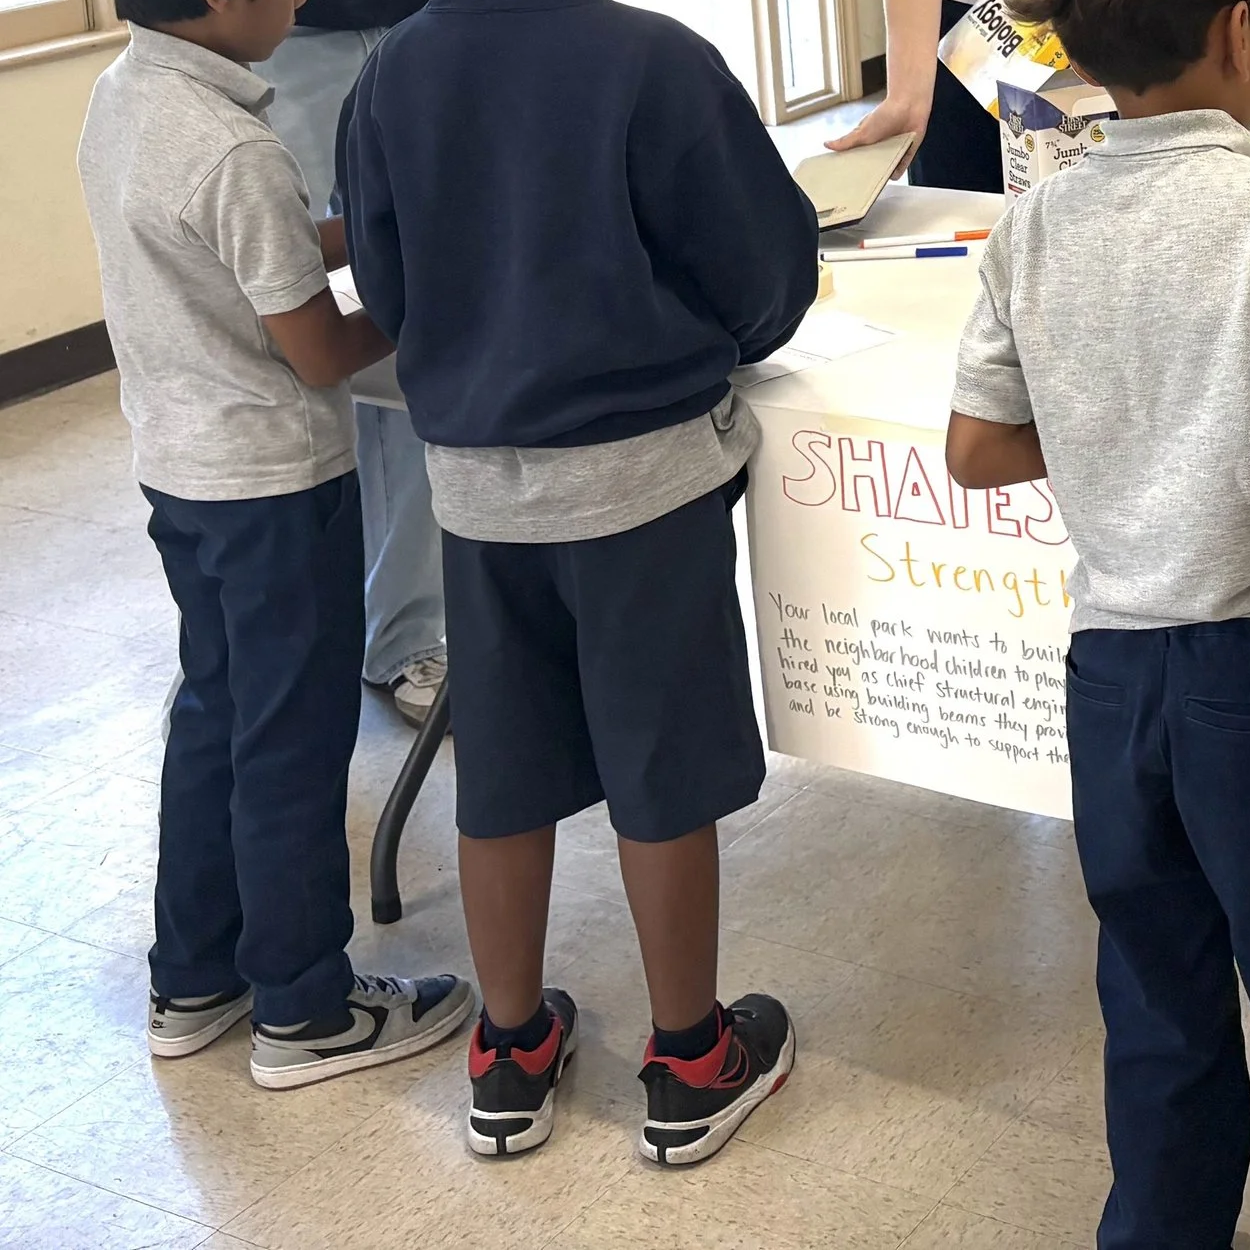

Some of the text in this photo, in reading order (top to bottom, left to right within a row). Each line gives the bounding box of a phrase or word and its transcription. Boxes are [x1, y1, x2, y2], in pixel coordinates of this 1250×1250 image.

[1006, 142, 1030, 161] Jumbo
[1008, 170, 1031, 189] Straws
[1010, 157, 1028, 174] Clear
[769, 591, 811, 623] Your
[821, 603, 859, 628] local
[870, 619, 913, 638] park
[927, 628, 980, 649] wants
[989, 632, 1008, 654] to
[777, 646, 819, 674] hired
[826, 664, 851, 687] you
[861, 670, 879, 685] as
[886, 670, 926, 694] chief
[936, 679, 1016, 709] structural
[780, 627, 1067, 697] the neighborhood children to play
[782, 673, 818, 694] base
[824, 683, 860, 711] using
[866, 687, 930, 724] building
[938, 705, 987, 728] beams
[993, 712, 1028, 742] they
[789, 698, 815, 717] and
[824, 701, 842, 718] be
[853, 708, 900, 739] strong
[906, 720, 960, 750] enough
[964, 732, 981, 748] to
[988, 738, 1040, 765] support
